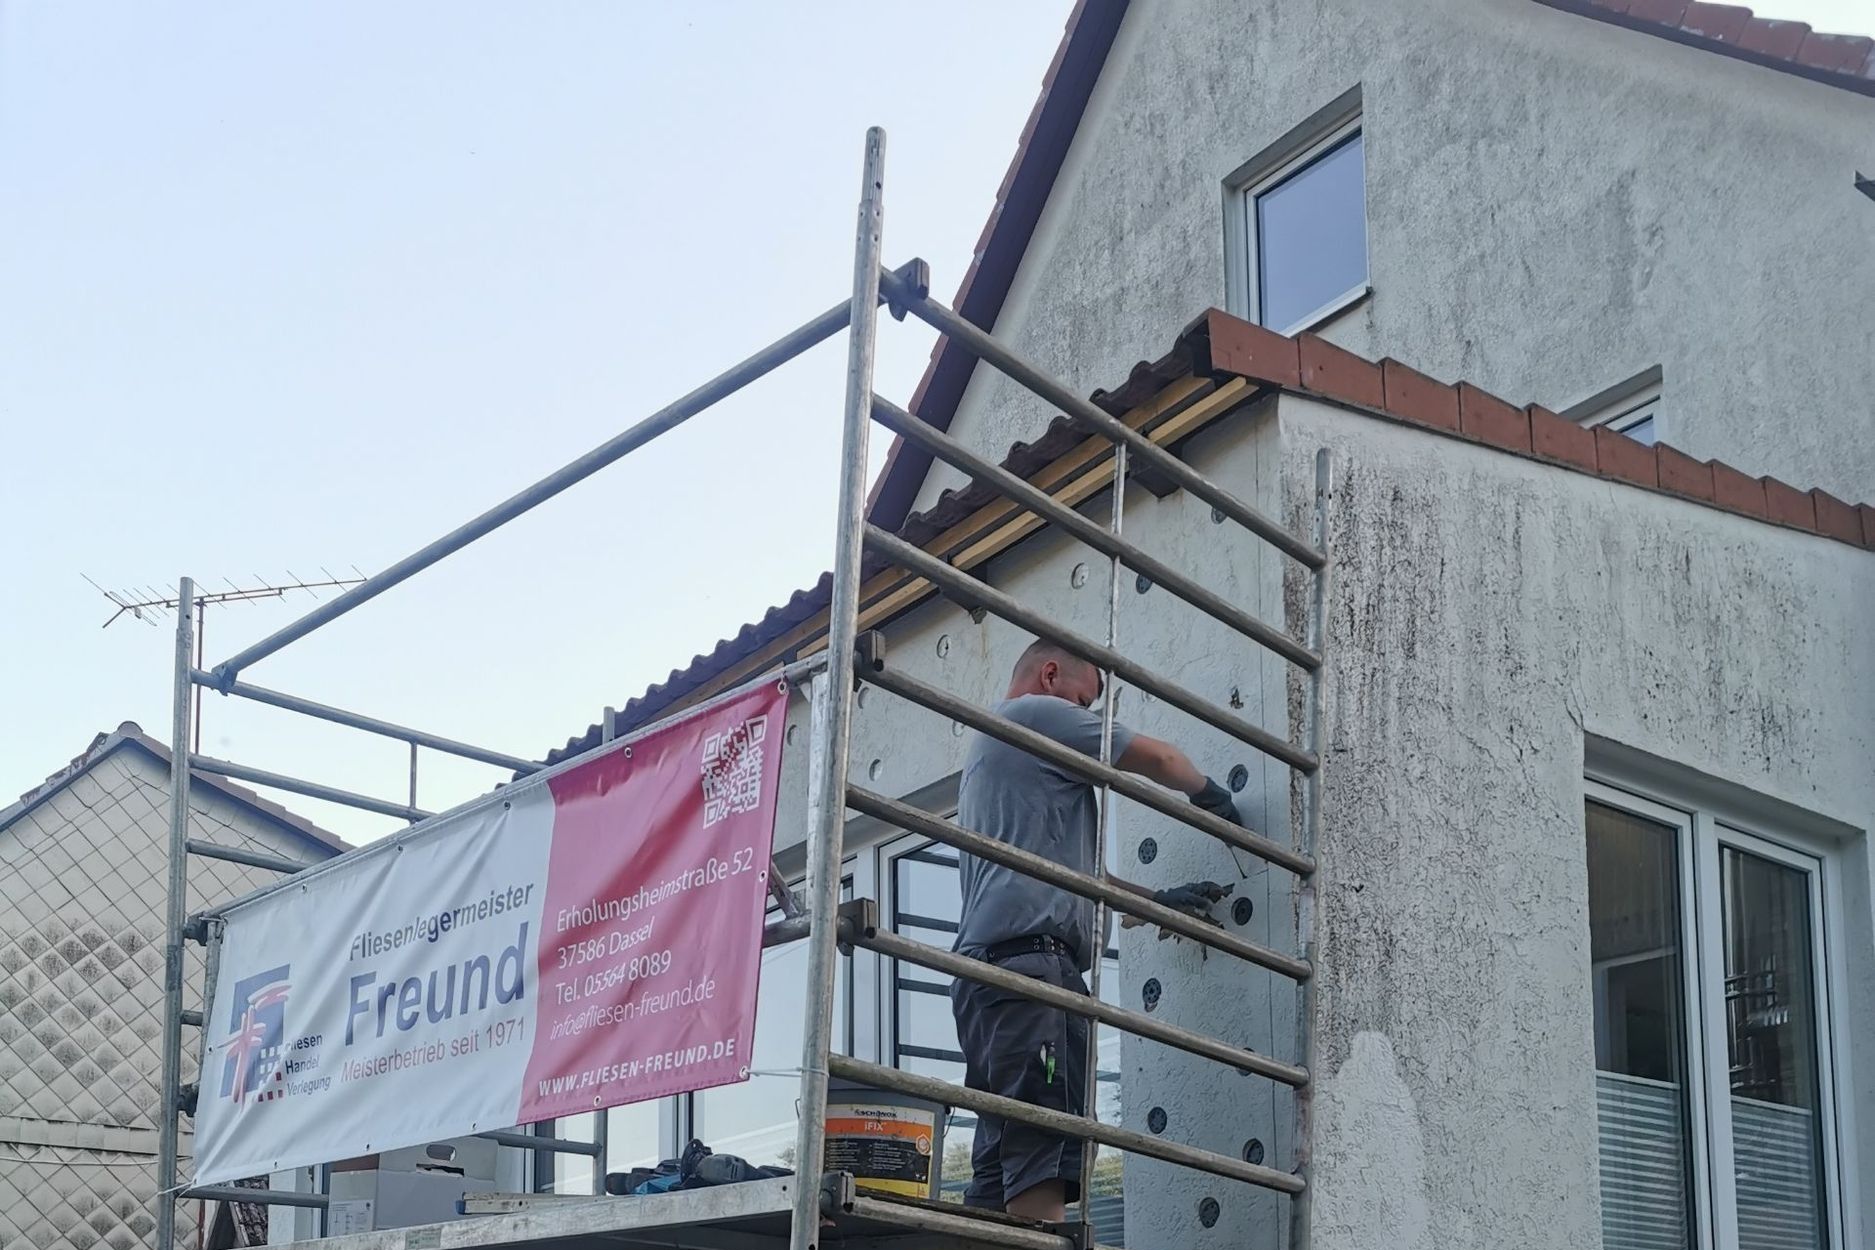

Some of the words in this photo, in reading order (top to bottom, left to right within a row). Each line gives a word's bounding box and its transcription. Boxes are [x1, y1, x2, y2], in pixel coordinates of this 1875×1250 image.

[557, 858, 728, 932] Erholungsheimstraße
[730, 847, 754, 876] 52
[349, 883, 534, 962] Fliesenlegermeister
[557, 936, 606, 970] 37586
[609, 916, 654, 954] Dassel
[345, 921, 528, 1046] Freund
[550, 975, 716, 1041] info@fliesen-freund.de
[555, 977, 581, 1005] Tel.
[584, 962, 627, 997] 05564
[628, 949, 673, 982] 8089
[285, 1056, 320, 1075] Handel
[340, 1038, 446, 1083] Meisterbetrieb
[450, 1030, 480, 1057] seit
[486, 1016, 526, 1049] 1971
[538, 1038, 736, 1097] WWW.FLIESEN-FREUND.DE
[287, 1076, 332, 1097] Verlegung
